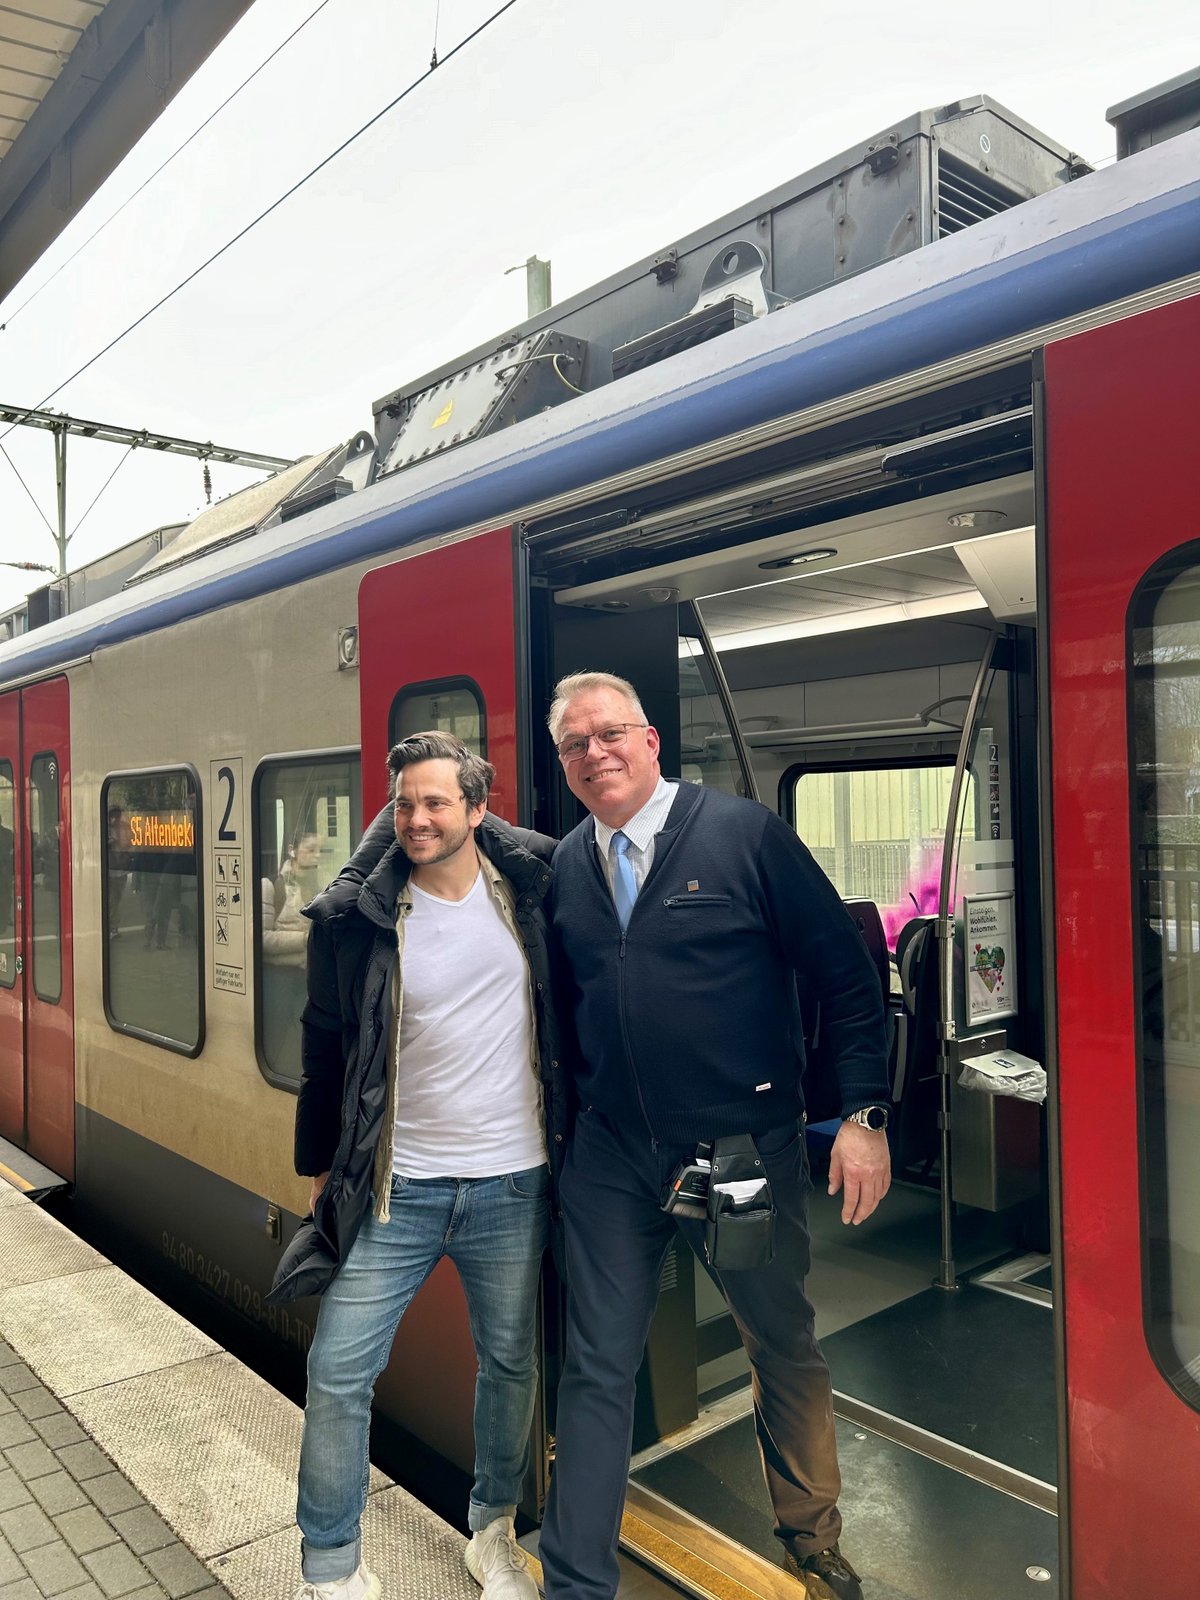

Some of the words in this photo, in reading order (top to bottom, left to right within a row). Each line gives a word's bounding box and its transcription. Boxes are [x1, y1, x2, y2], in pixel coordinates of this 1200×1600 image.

[990, 745, 997, 761] 2
[218, 766, 236, 841] 2
[130, 816, 143, 846] S5
[162, 1231, 177, 1260] 94
[179, 1242, 194, 1274] 80
[197, 1254, 230, 1298] 3427
[281, 1308, 315, 1354] D-TD
